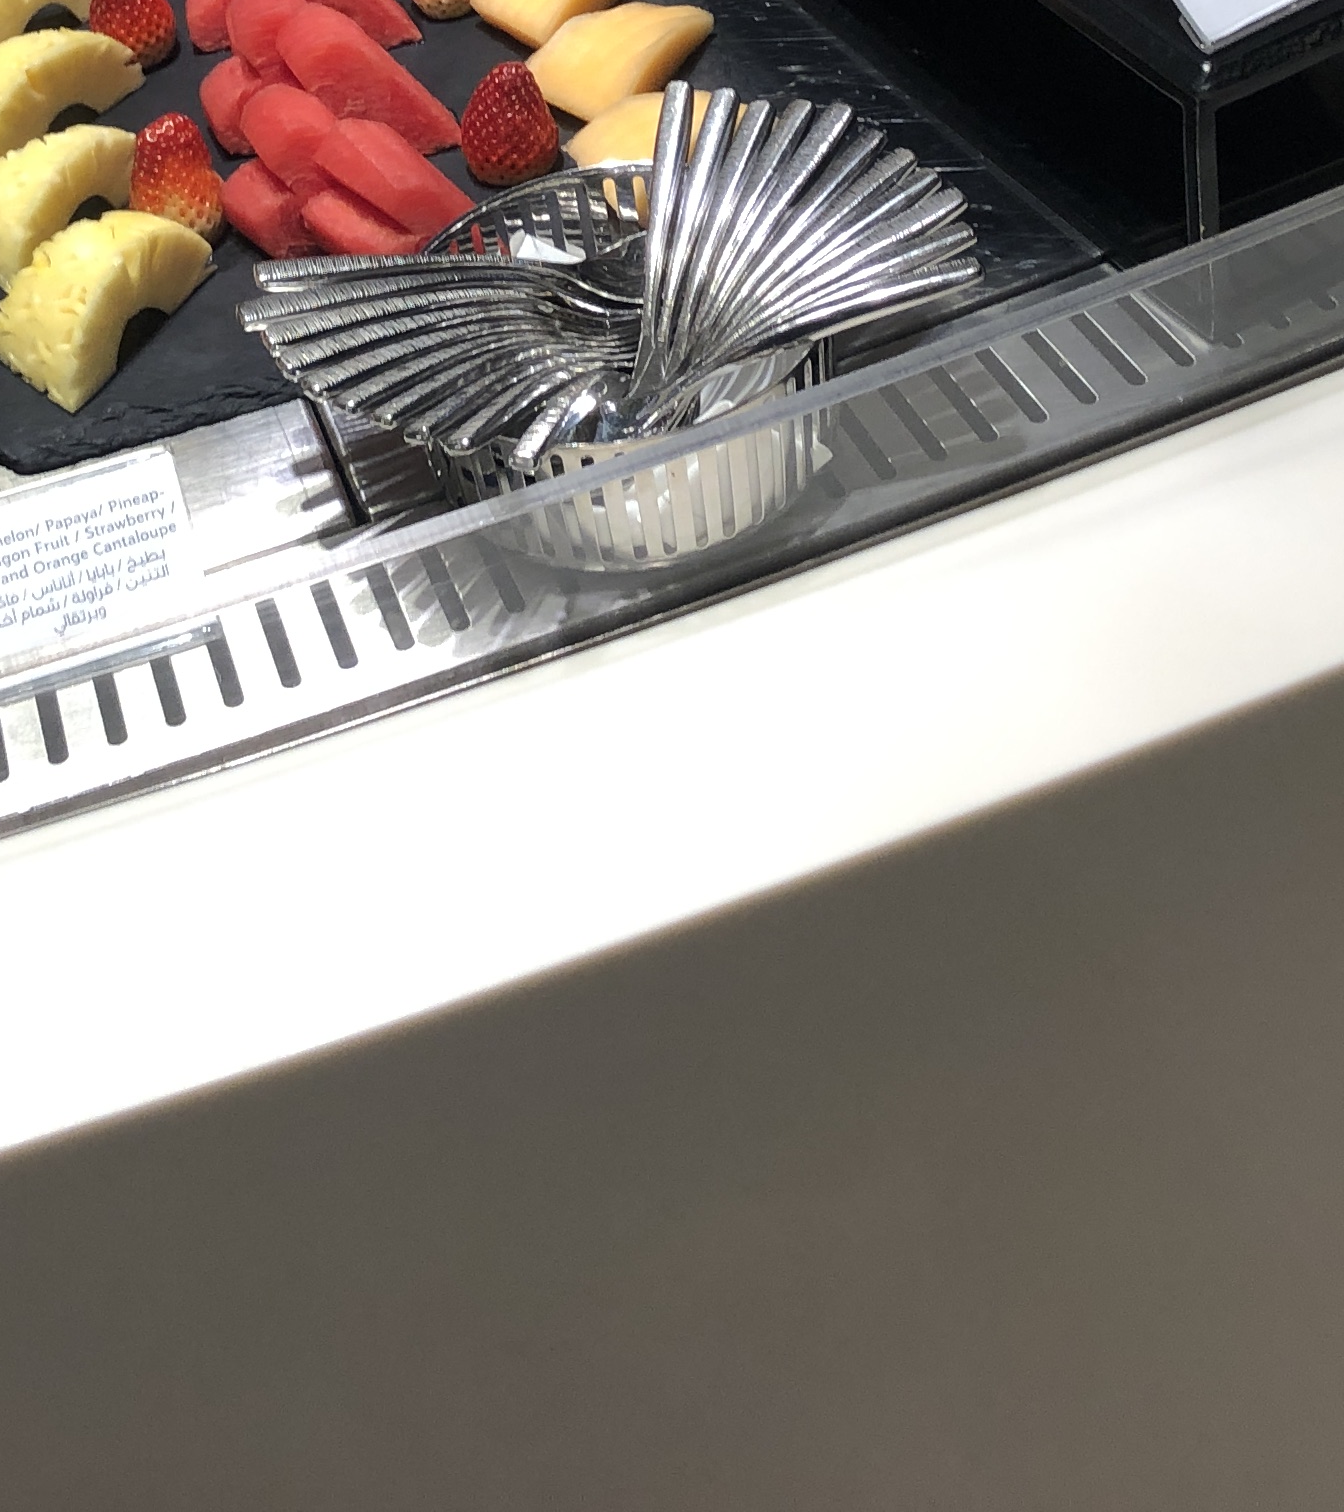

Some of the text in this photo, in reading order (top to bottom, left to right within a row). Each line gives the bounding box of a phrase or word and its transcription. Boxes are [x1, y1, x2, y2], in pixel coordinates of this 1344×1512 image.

[35, 536, 70, 555] Fruit
[84, 506, 165, 540] Strawberry
[45, 504, 102, 532] Papaya/
[108, 489, 165, 513] Pineap-
[1, 566, 29, 586] and
[34, 550, 89, 574] Orange
[94, 522, 177, 556] Cantaloupe
